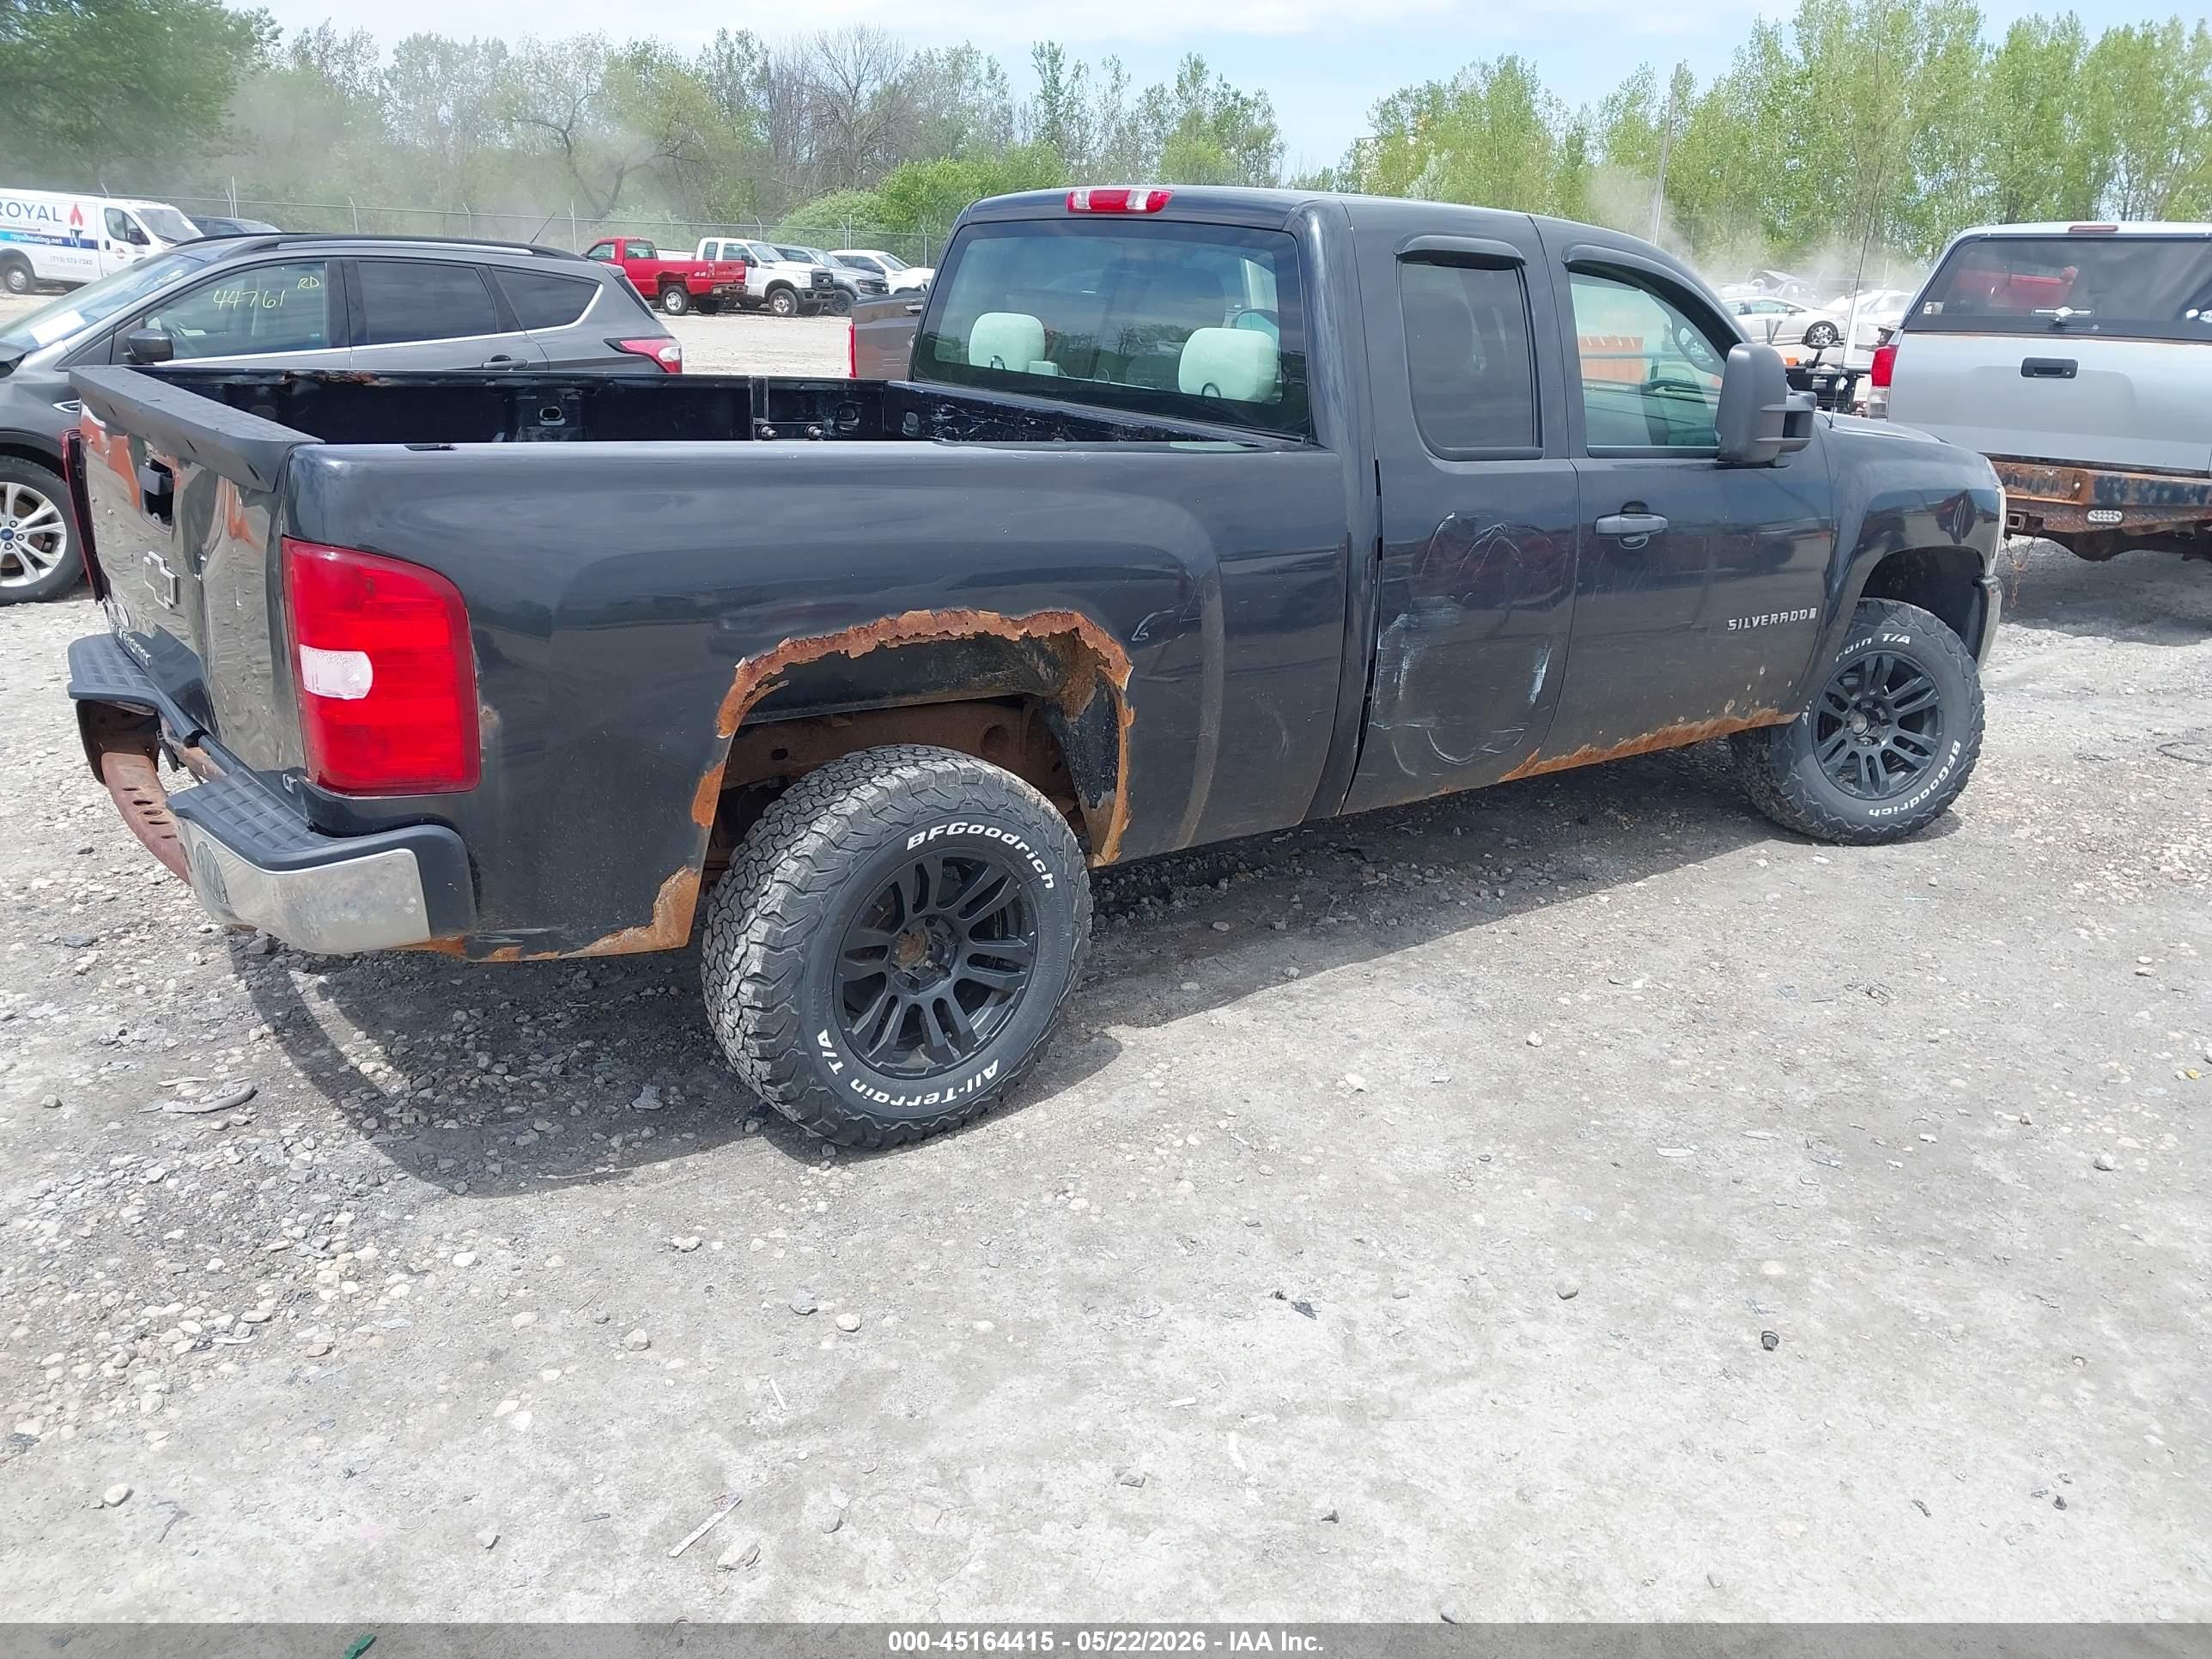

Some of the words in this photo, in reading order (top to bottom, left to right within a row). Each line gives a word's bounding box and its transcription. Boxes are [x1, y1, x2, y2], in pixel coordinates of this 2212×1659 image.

[9, 234, 63, 245] royalheating.net
[297, 275, 320, 289] RD
[213, 289, 286, 311] 44761
[1726, 608, 1808, 632] SILVERADO
[1881, 633, 1911, 646] T/A
[1868, 739, 1963, 818] BFGoodrich
[906, 821, 1056, 890] BFGoodrich
[816, 1028, 845, 1076] T/A
[849, 1058, 1000, 1109] All-Terrain
